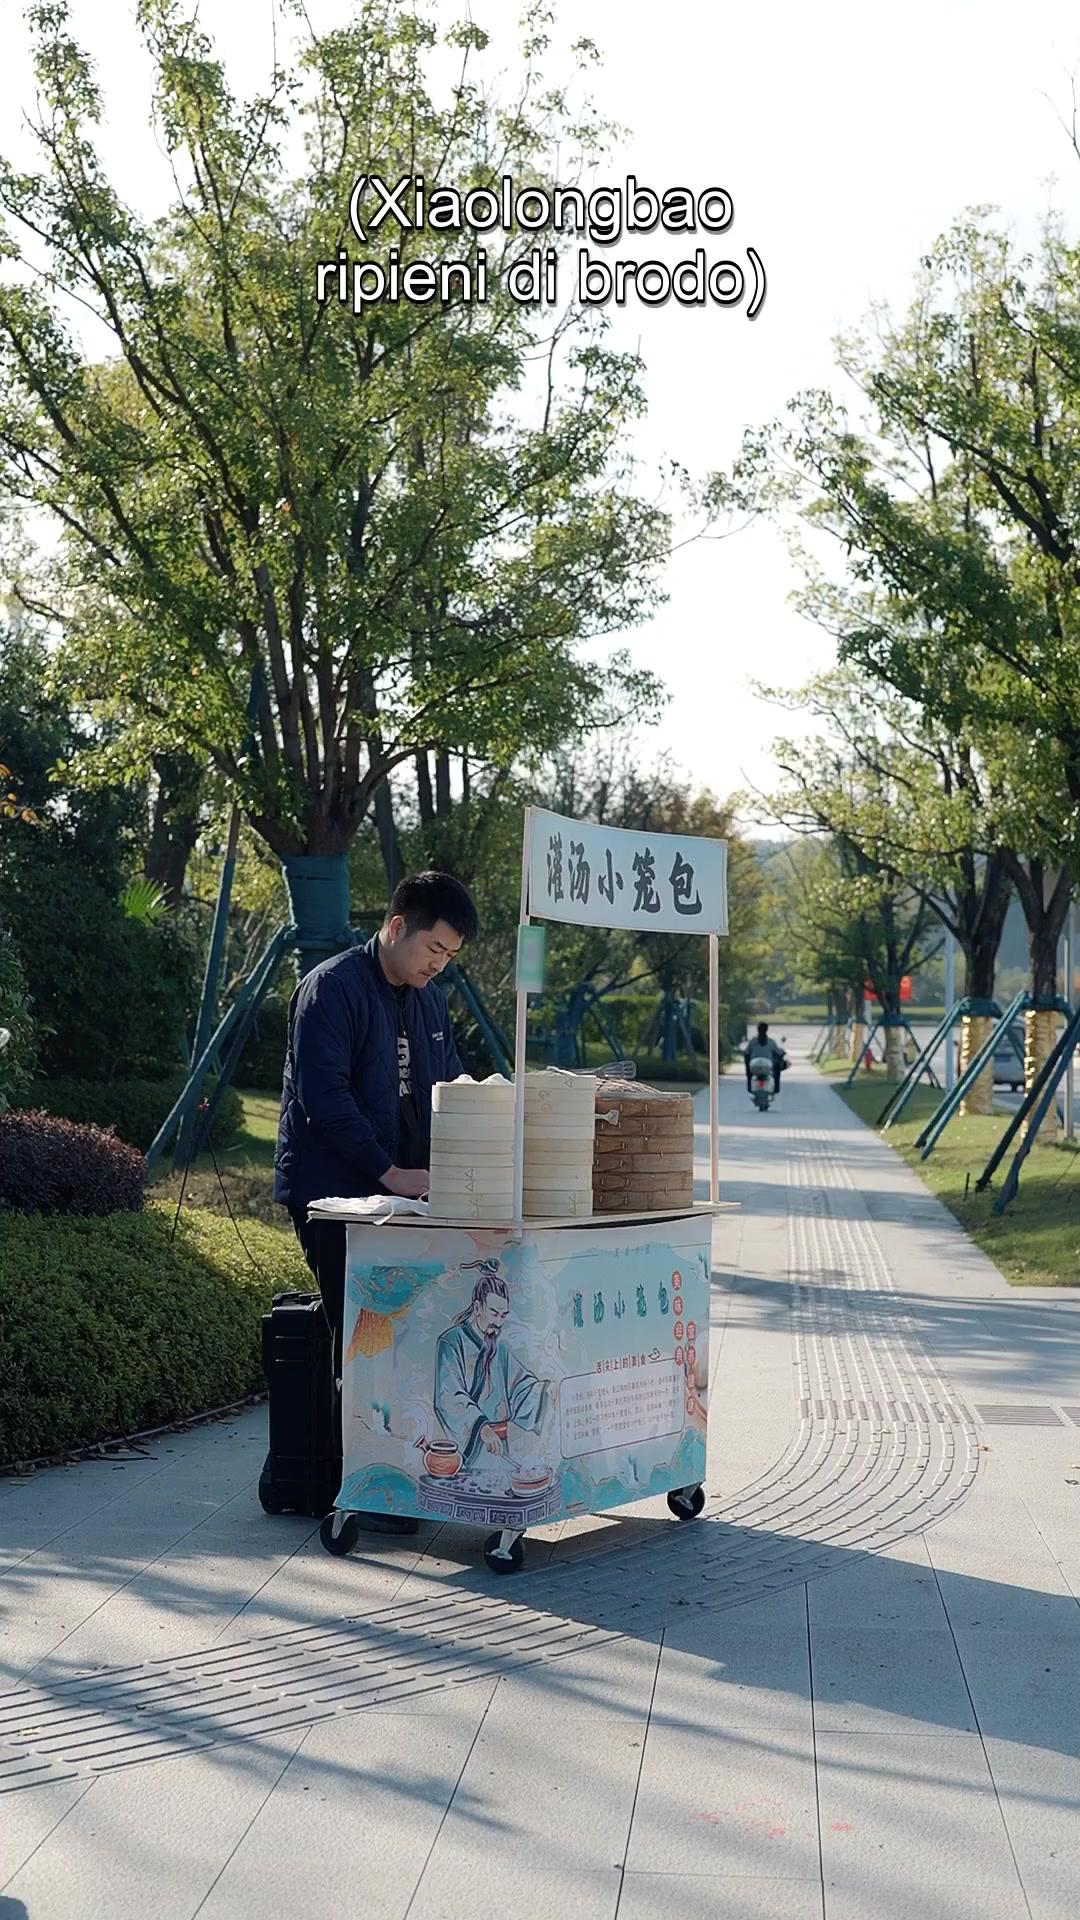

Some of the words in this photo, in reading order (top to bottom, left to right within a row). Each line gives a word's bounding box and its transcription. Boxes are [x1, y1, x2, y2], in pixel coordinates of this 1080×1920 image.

[546, 831, 702, 916] 灌汤小笼包
